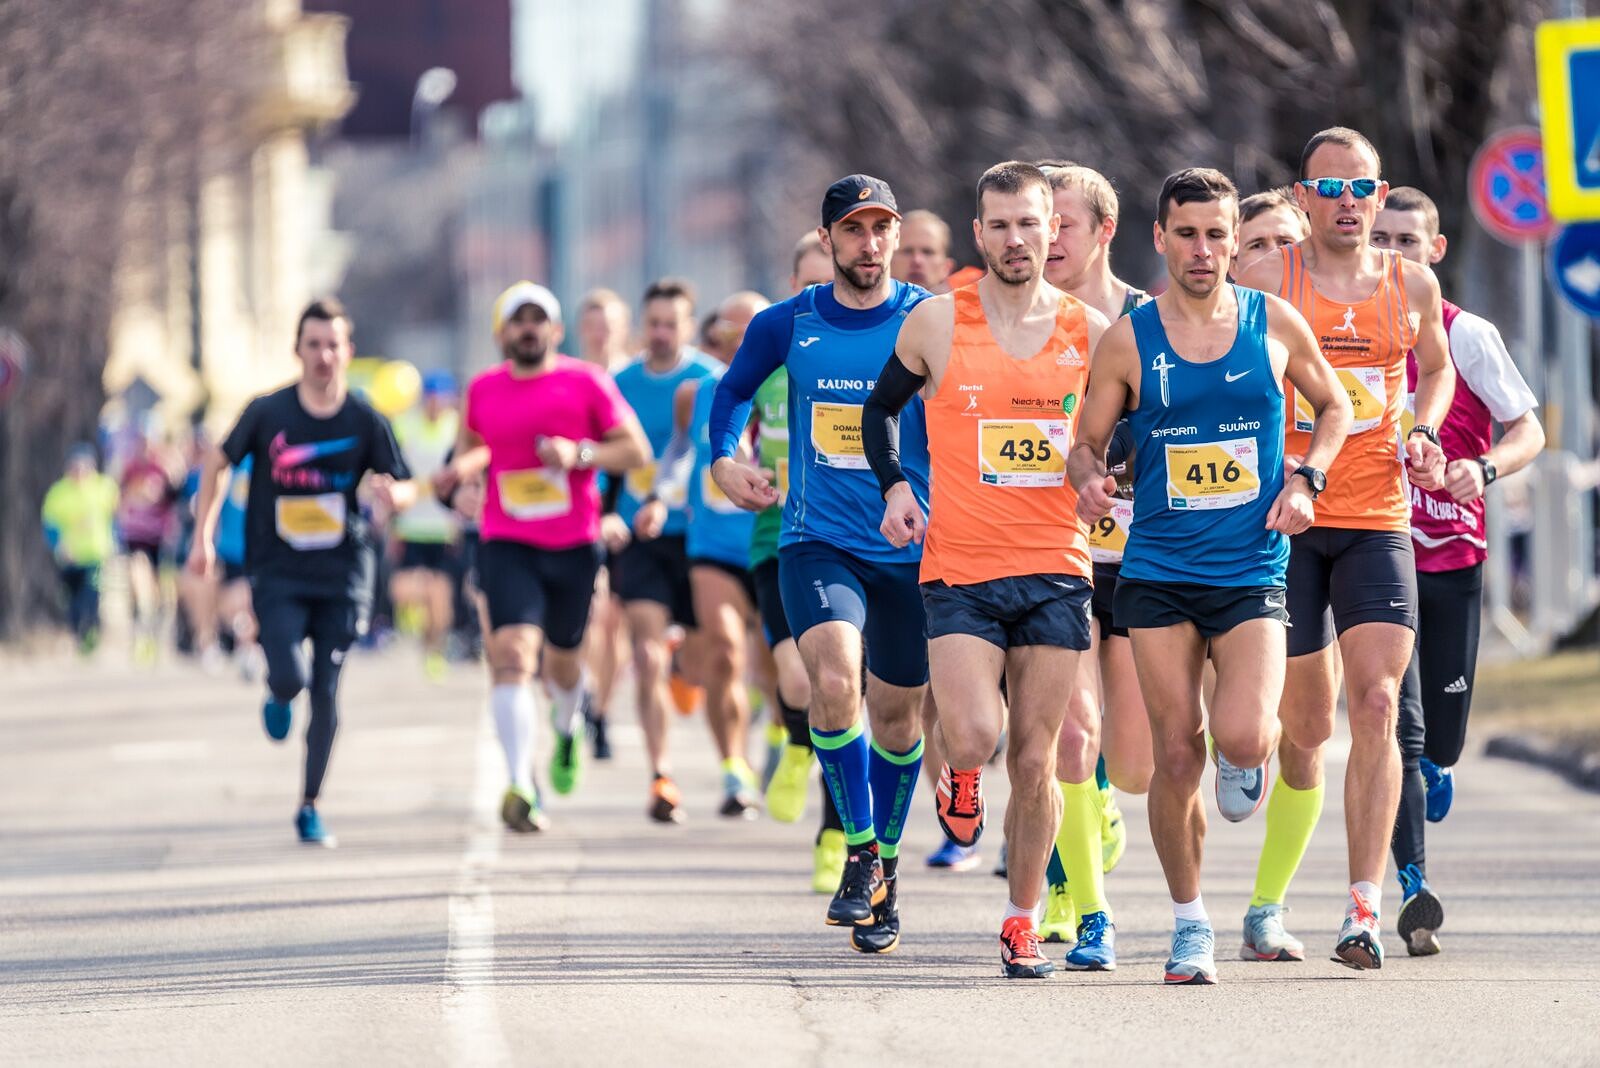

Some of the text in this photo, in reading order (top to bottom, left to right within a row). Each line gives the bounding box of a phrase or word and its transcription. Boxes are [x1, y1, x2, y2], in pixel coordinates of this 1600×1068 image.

[817, 378, 878, 390] KAUNO B
[1047, 399, 1061, 407] MR
[1151, 426, 1198, 438] SYFORM
[1218, 420, 1260, 432] SUUNTO
[999, 439, 1051, 461] 435
[1186, 460, 1241, 485] 416
[1425, 493, 1459, 520] KLUBS
